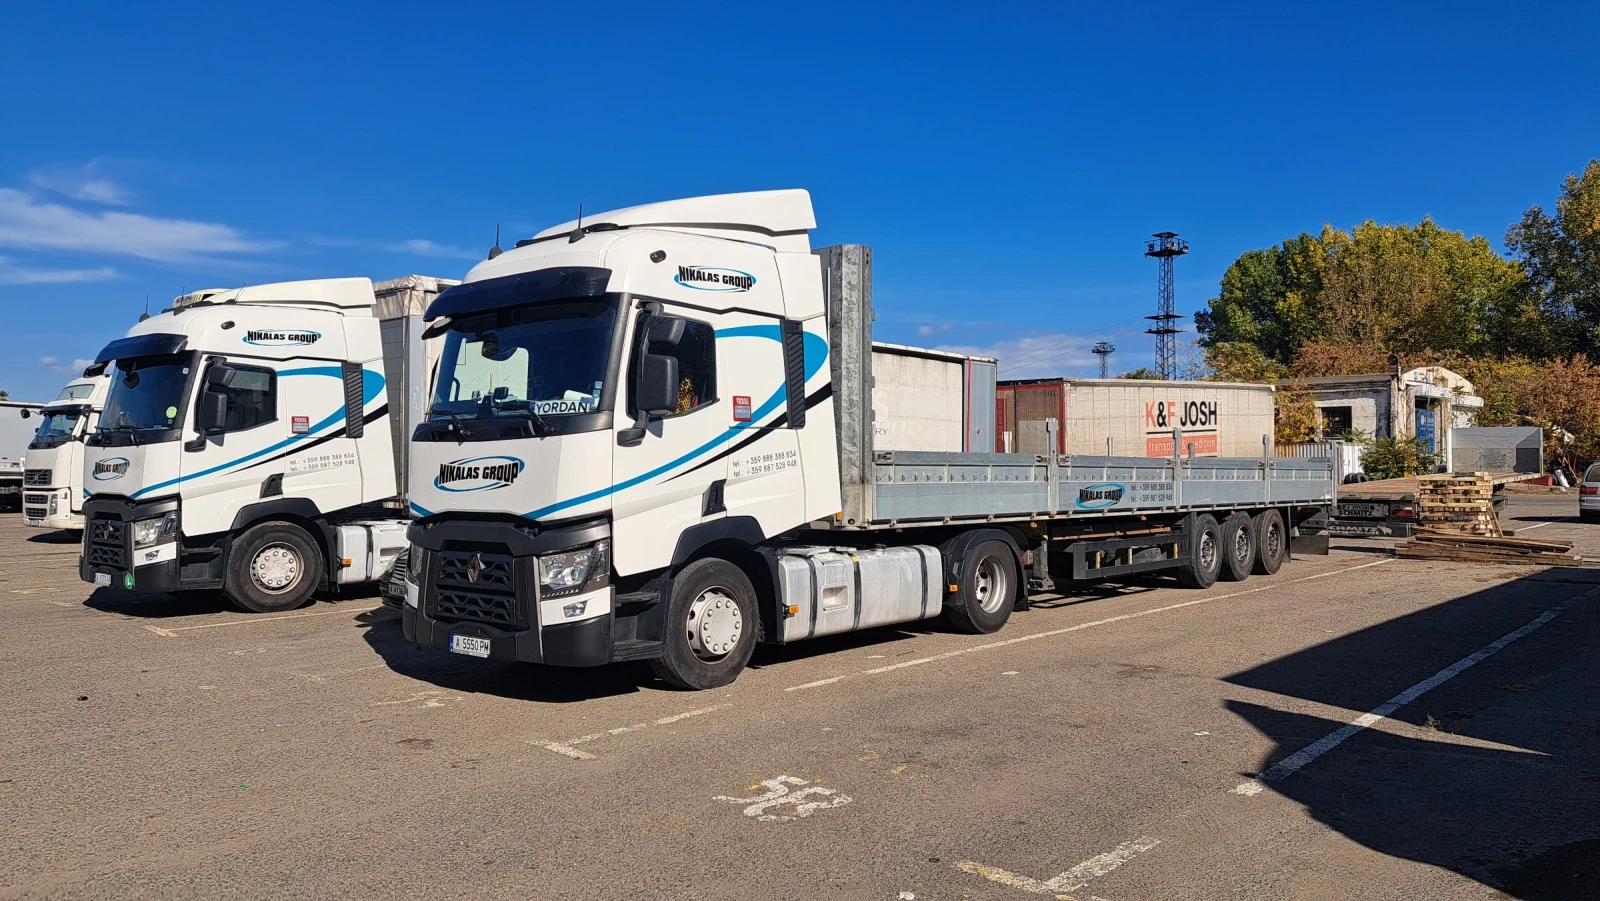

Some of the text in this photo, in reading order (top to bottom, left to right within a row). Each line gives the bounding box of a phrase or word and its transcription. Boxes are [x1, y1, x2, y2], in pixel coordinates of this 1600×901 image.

[678, 265, 753, 291] NIKALAS GROUP
[247, 330, 317, 344] NIKALAS GROUP
[536, 402, 587, 414] YORDAN
[1146, 401, 1217, 427] K&F JOSH
[745, 456, 761, 465] +359
[439, 462, 519, 485] NIKALAS GROUP
[746, 466, 762, 474] +359
[1079, 488, 1122, 504] NIKALAS GROUP
[127, 577, 132, 586] L
[456, 637, 460, 648] A
